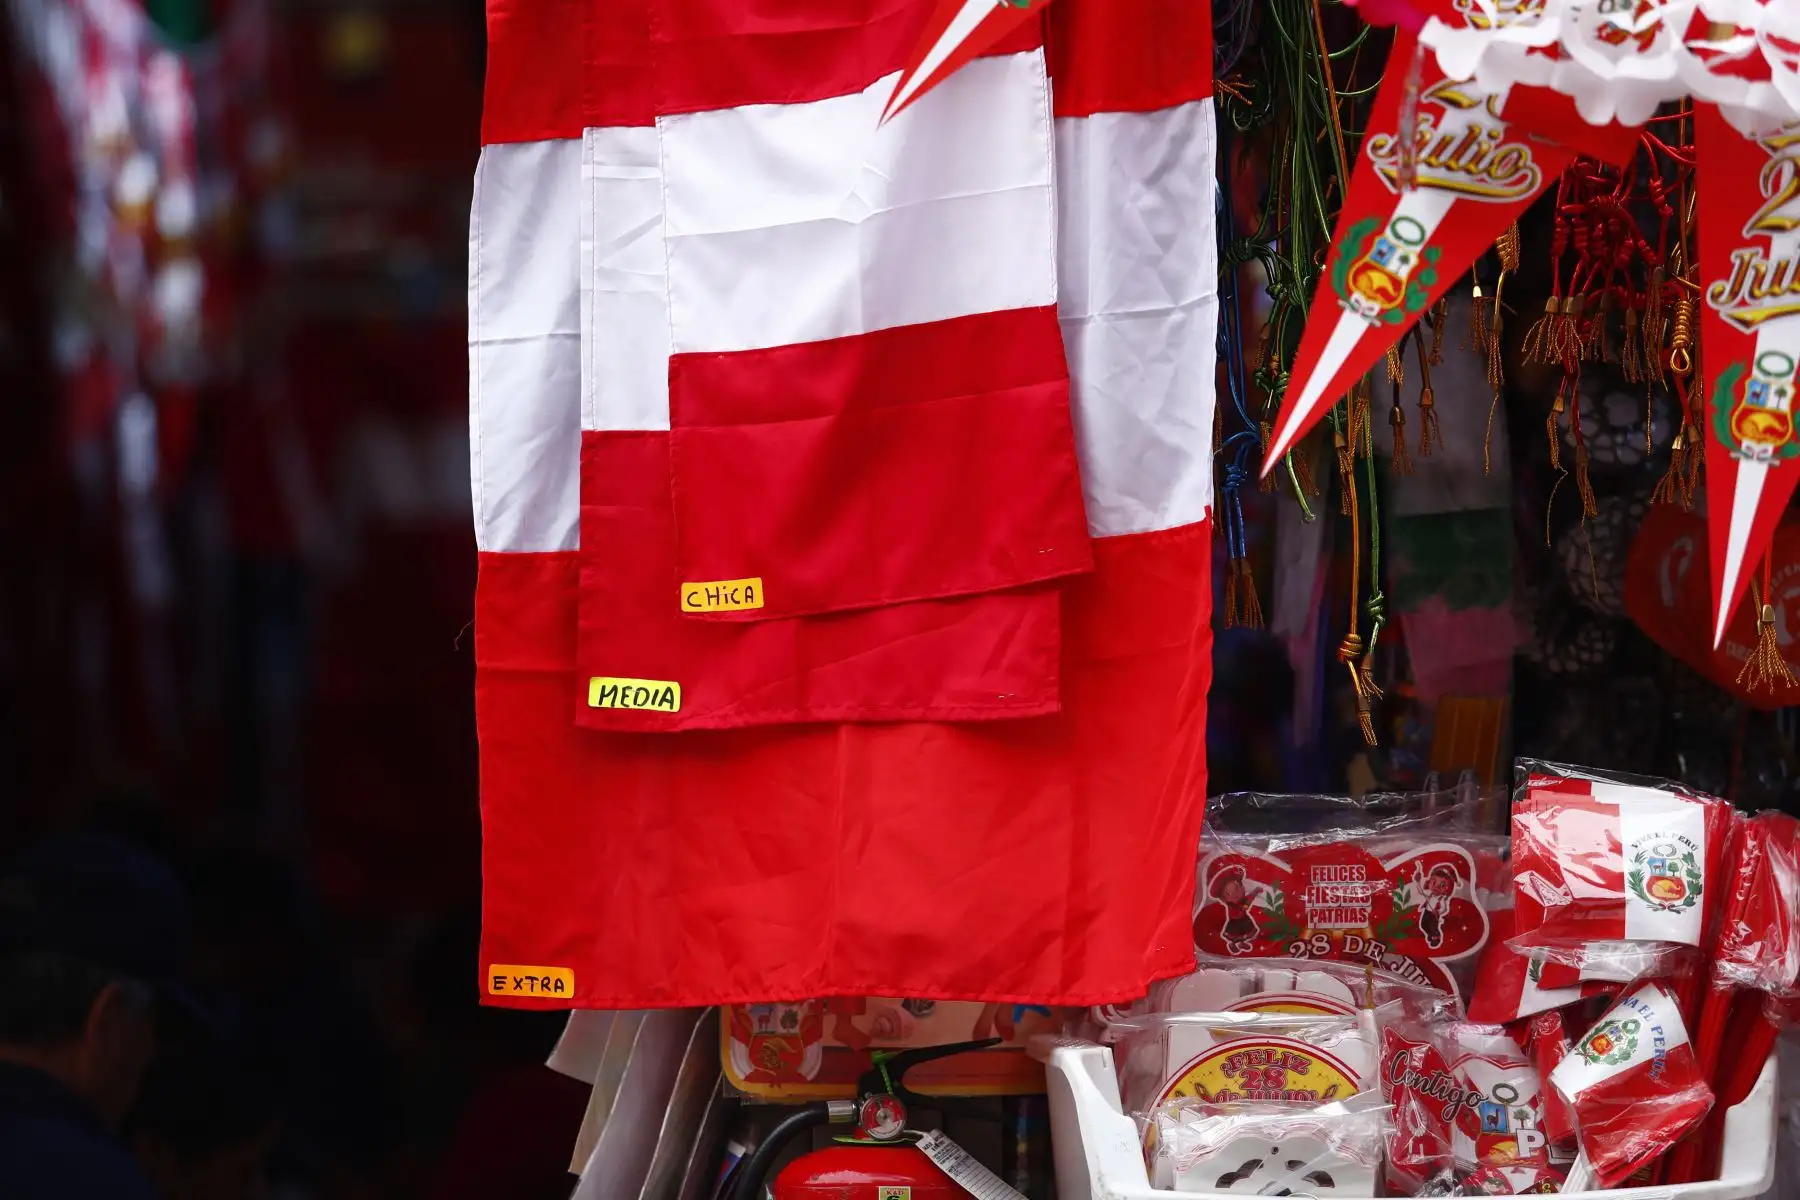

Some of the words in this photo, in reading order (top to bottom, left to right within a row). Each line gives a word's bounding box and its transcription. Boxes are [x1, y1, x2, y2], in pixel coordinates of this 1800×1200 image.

[598, 684, 675, 710] MEDIA
[1312, 865, 1366, 882] FELICES
[1306, 884, 1371, 905] FIESTAS
[1309, 907, 1368, 925] PATRIAS
[1289, 934, 1332, 960] 28
[1342, 934, 1386, 962] DE
[493, 976, 565, 993] EXTRA
[1638, 1004, 1654, 1022] EL
[1239, 1066, 1288, 1091] 28
[1390, 1050, 1489, 1122] Contigo
